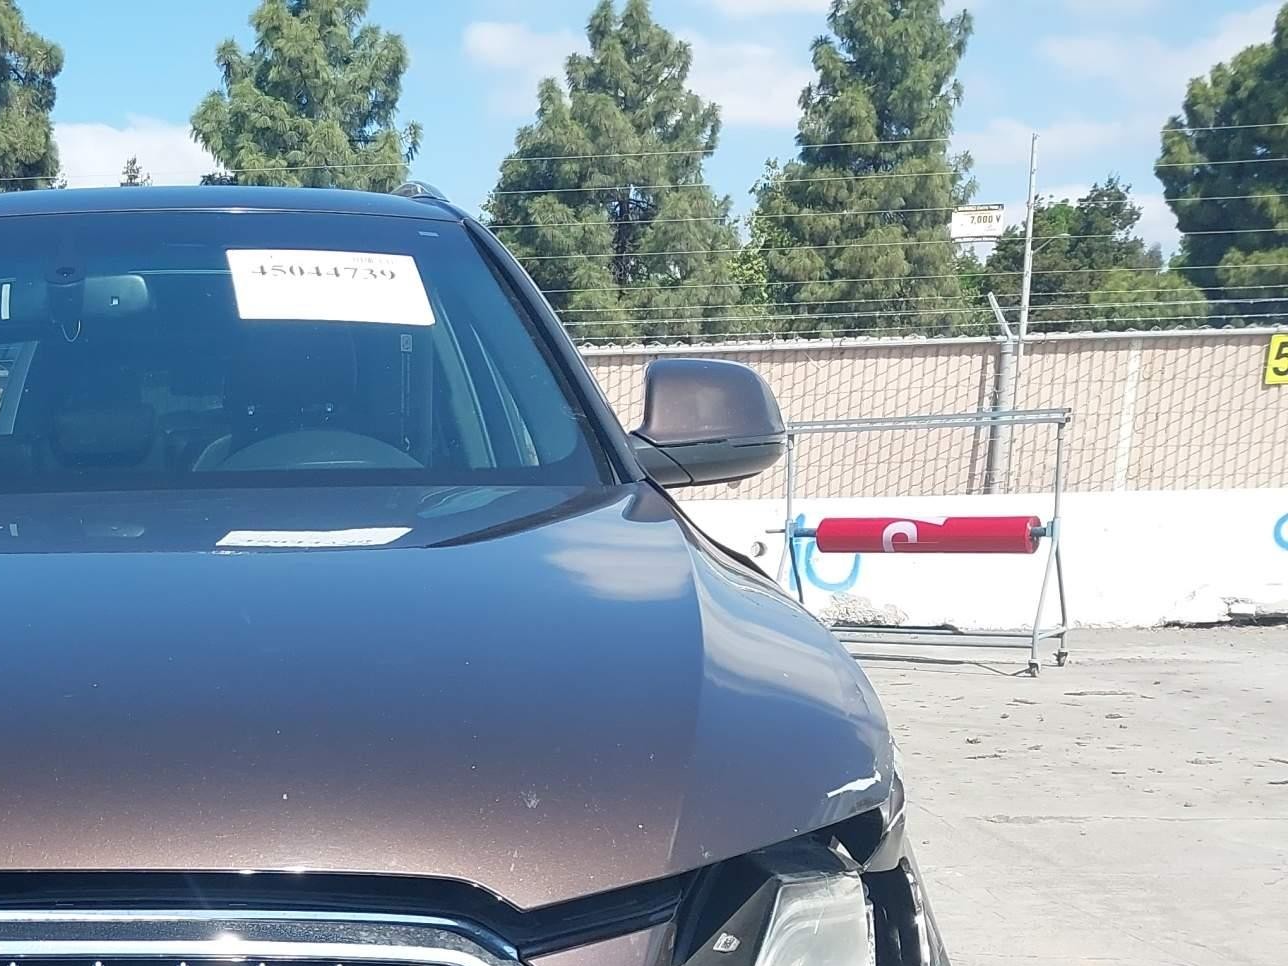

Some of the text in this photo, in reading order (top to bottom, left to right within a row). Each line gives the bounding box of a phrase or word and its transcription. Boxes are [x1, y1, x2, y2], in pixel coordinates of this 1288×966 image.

[970, 215, 993, 224] 7,000
[996, 214, 1002, 223] V
[252, 265, 396, 280] 45044739
